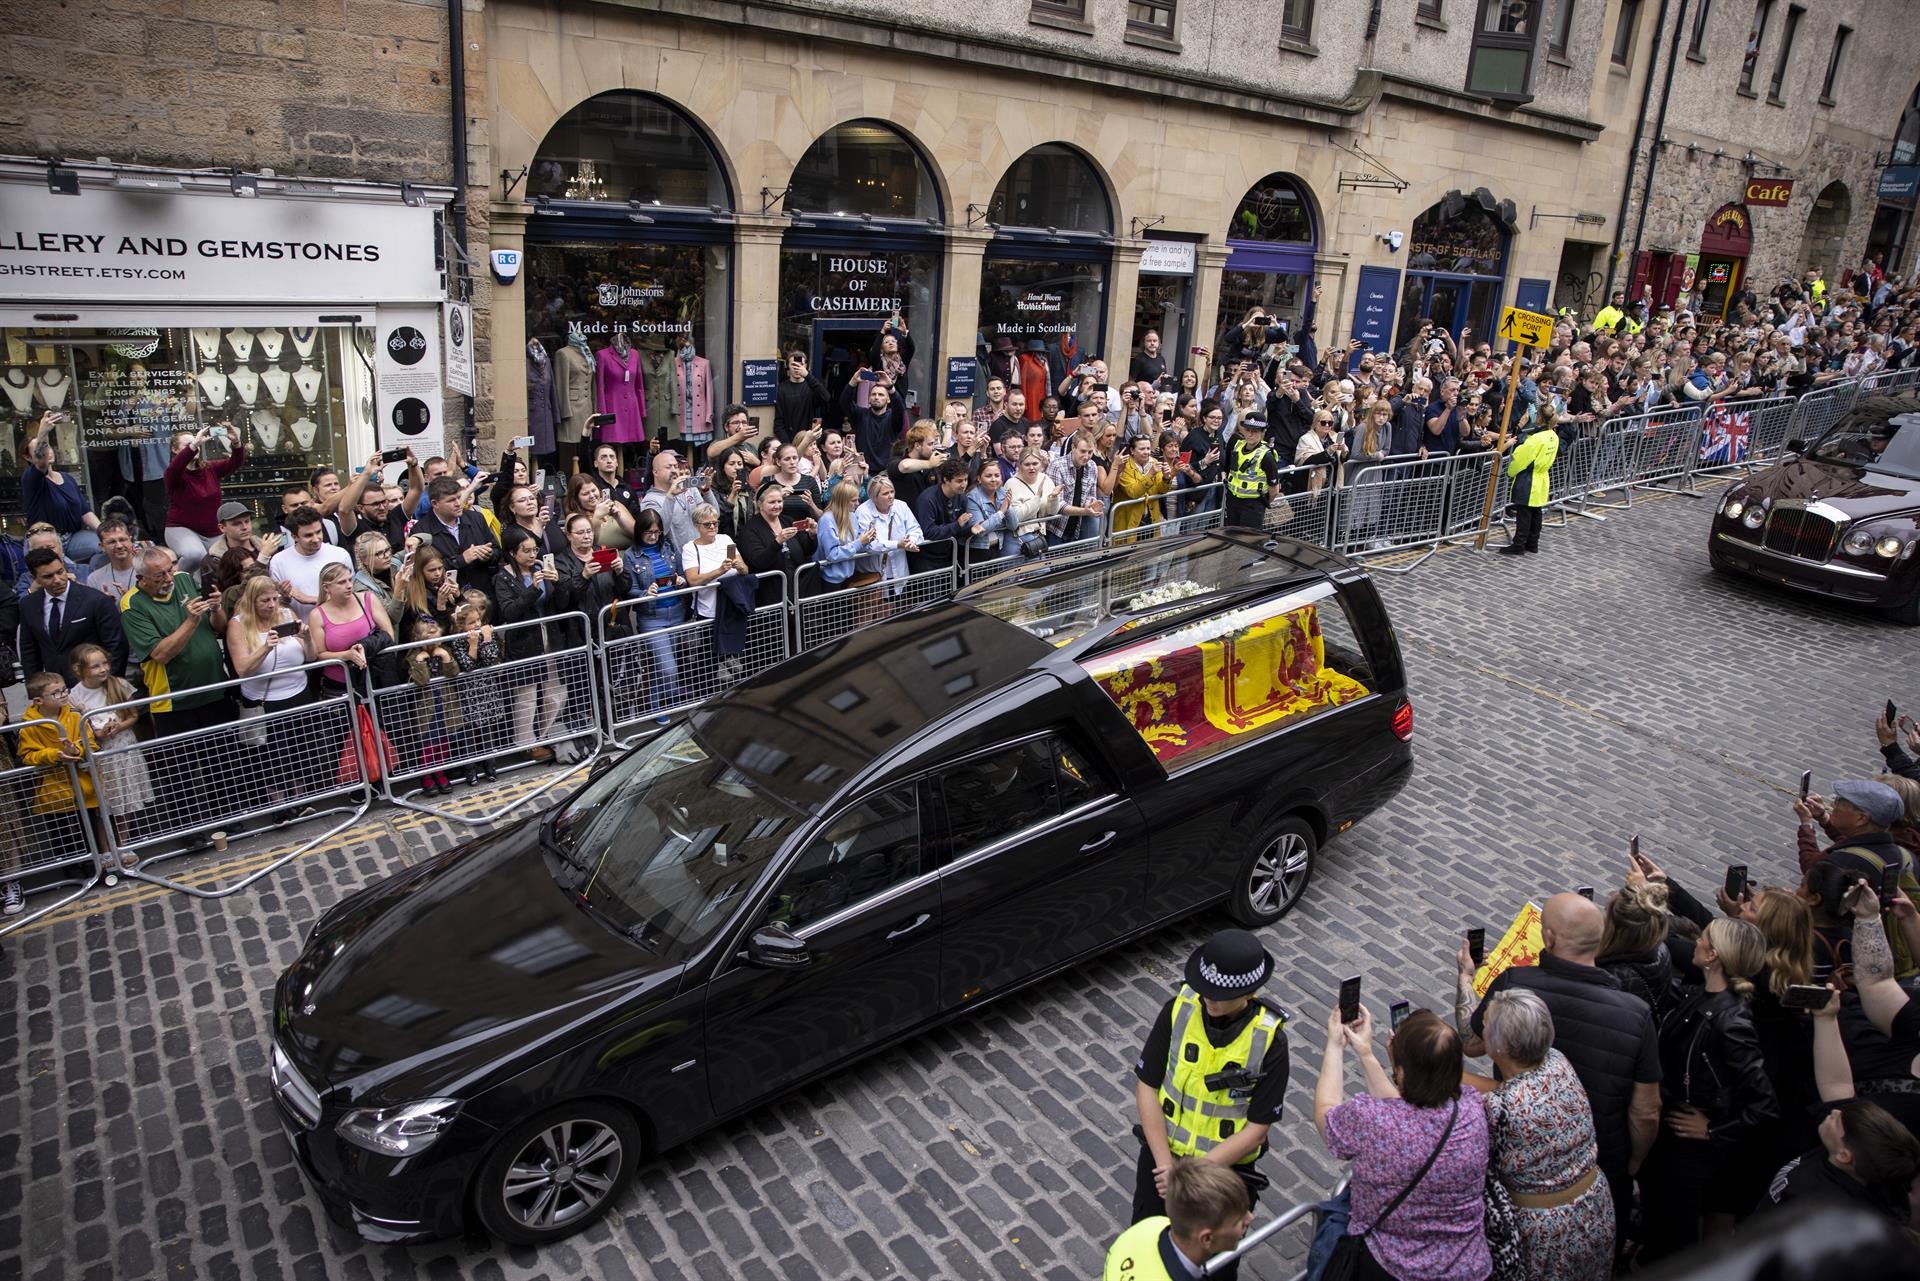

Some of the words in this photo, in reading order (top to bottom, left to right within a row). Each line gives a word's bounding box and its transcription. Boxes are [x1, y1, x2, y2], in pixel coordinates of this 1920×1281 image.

[1747, 184, 1789, 201] Cafe
[117, 236, 188, 256] AND
[197, 239, 381, 262] GEMSTONES
[1160, 244, 1168, 253] in
[1169, 244, 1182, 255] and
[1183, 247, 1193, 258] try
[1437, 244, 1451, 255] OF
[1452, 246, 1502, 261] SCOTLAND
[829, 257, 888, 274] HOUSE
[1150, 256, 1163, 267] free
[1163, 258, 1187, 269] sample
[849, 279, 868, 291] OF
[620, 286, 665, 298] Johnstons
[1027, 293, 1043, 301] Hand
[627, 298, 644, 306] Elgin
[810, 296, 902, 311] CASHMERE
[1517, 312, 1552, 326] CROSSING
[567, 320, 609, 334] Made
[613, 321, 627, 333] in
[632, 320, 693, 334] Scotland
[997, 323, 1023, 334] Made
[1026, 323, 1035, 333] in
[1038, 322, 1077, 333] Scotland
[1522, 322, 1542, 332] POINT
[88, 371, 127, 379] EXTRA
[129, 370, 187, 378] SERVICES:
[83, 379, 150, 388] JEWELLERY
[154, 379, 194, 387] REPAIR
[105, 388, 176, 397] ENGRAVINGS
[95, 416, 159, 426] SCOTTISH
[161, 414, 195, 422] GEMS
[82, 427, 114, 436] IONA
[116, 425, 159, 434] GREEN
[160, 422, 209, 432] MARBLE
